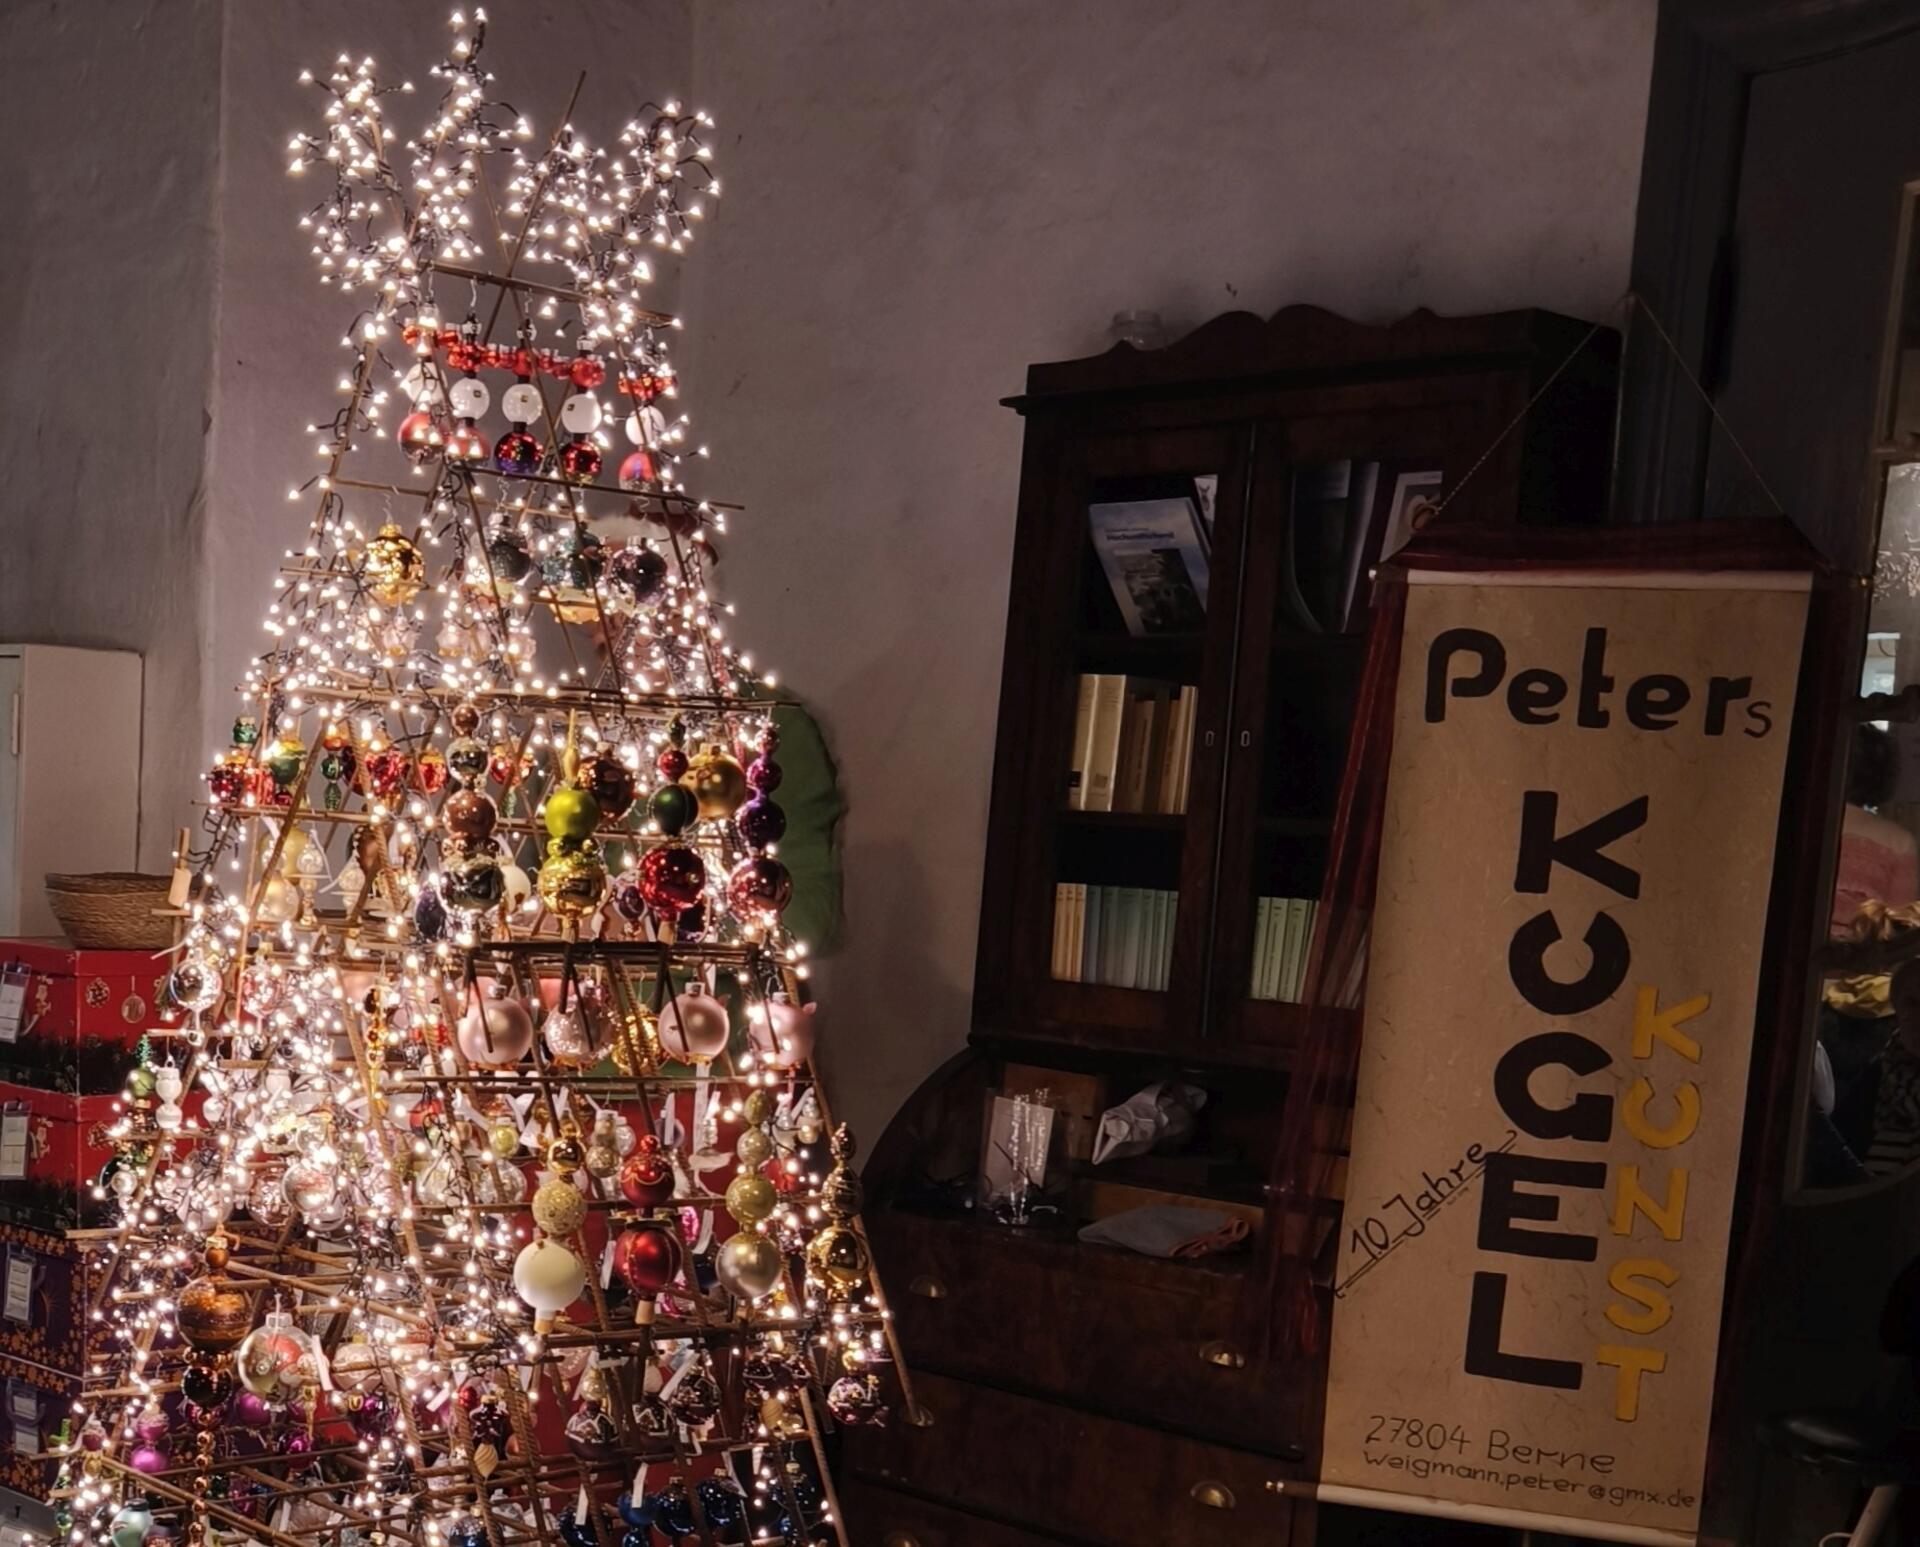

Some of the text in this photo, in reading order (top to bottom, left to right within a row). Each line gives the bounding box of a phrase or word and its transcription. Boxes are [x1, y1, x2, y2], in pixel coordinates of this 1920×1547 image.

[1425, 627, 1772, 738] Peters
[1465, 790, 1649, 1391] KUGEL
[1351, 1142, 1487, 1260] 10 Jahre
[1598, 984, 1712, 1423] KUNST
[1364, 1415, 1616, 1474] 27804 Berne
